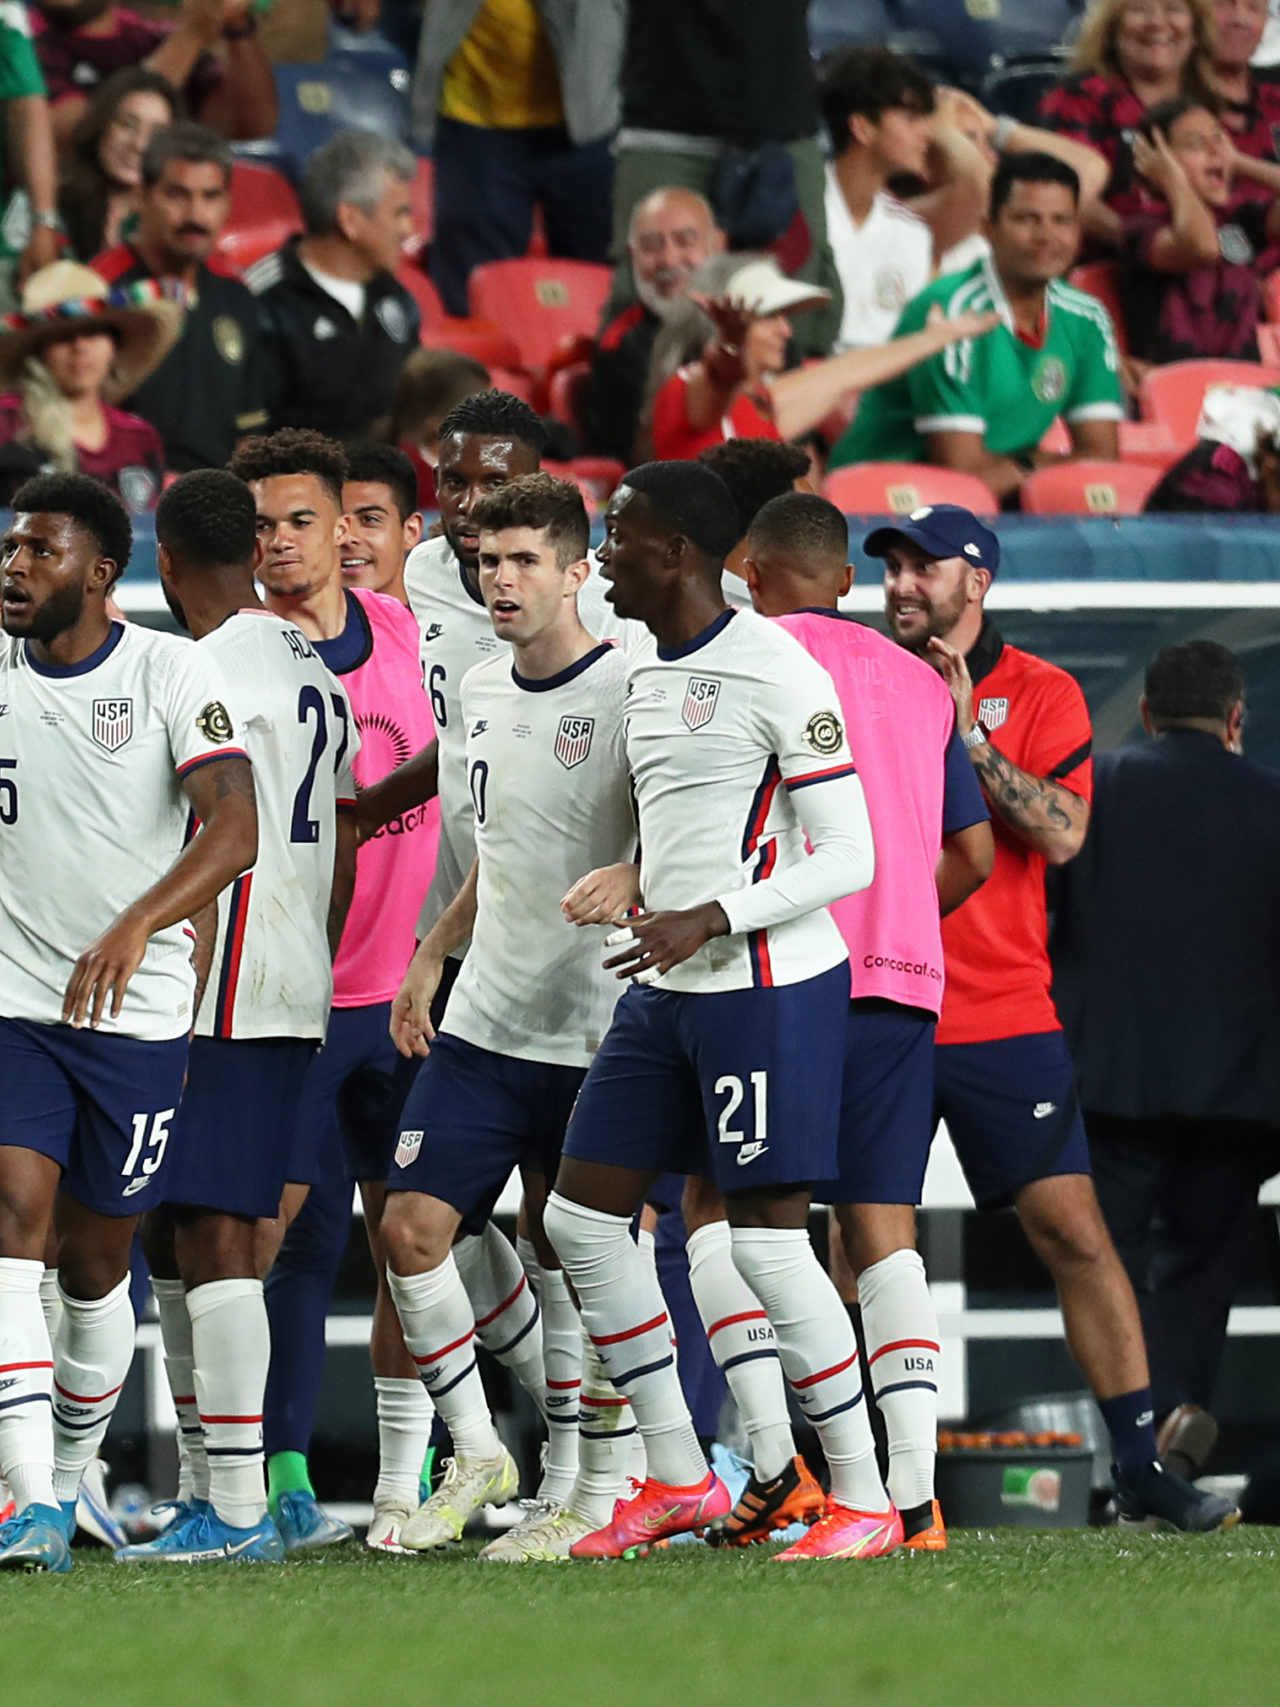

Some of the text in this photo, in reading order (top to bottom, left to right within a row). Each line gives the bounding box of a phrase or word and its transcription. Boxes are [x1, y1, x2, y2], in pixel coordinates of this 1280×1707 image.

[281, 630, 317, 660] AC
[422, 661, 447, 728] 6
[690, 680, 717, 701] USA
[96, 702, 129, 721] USA
[981, 699, 1007, 712] USA
[562, 720, 591, 739] USA
[470, 760, 488, 824] 0
[714, 1071, 767, 1143] 21
[121, 1108, 175, 1176] 15
[400, 1133, 422, 1147] USA
[747, 1327, 774, 1342] USA
[904, 1357, 934, 1373] USA
[63, 1404, 95, 1415] NIKE
